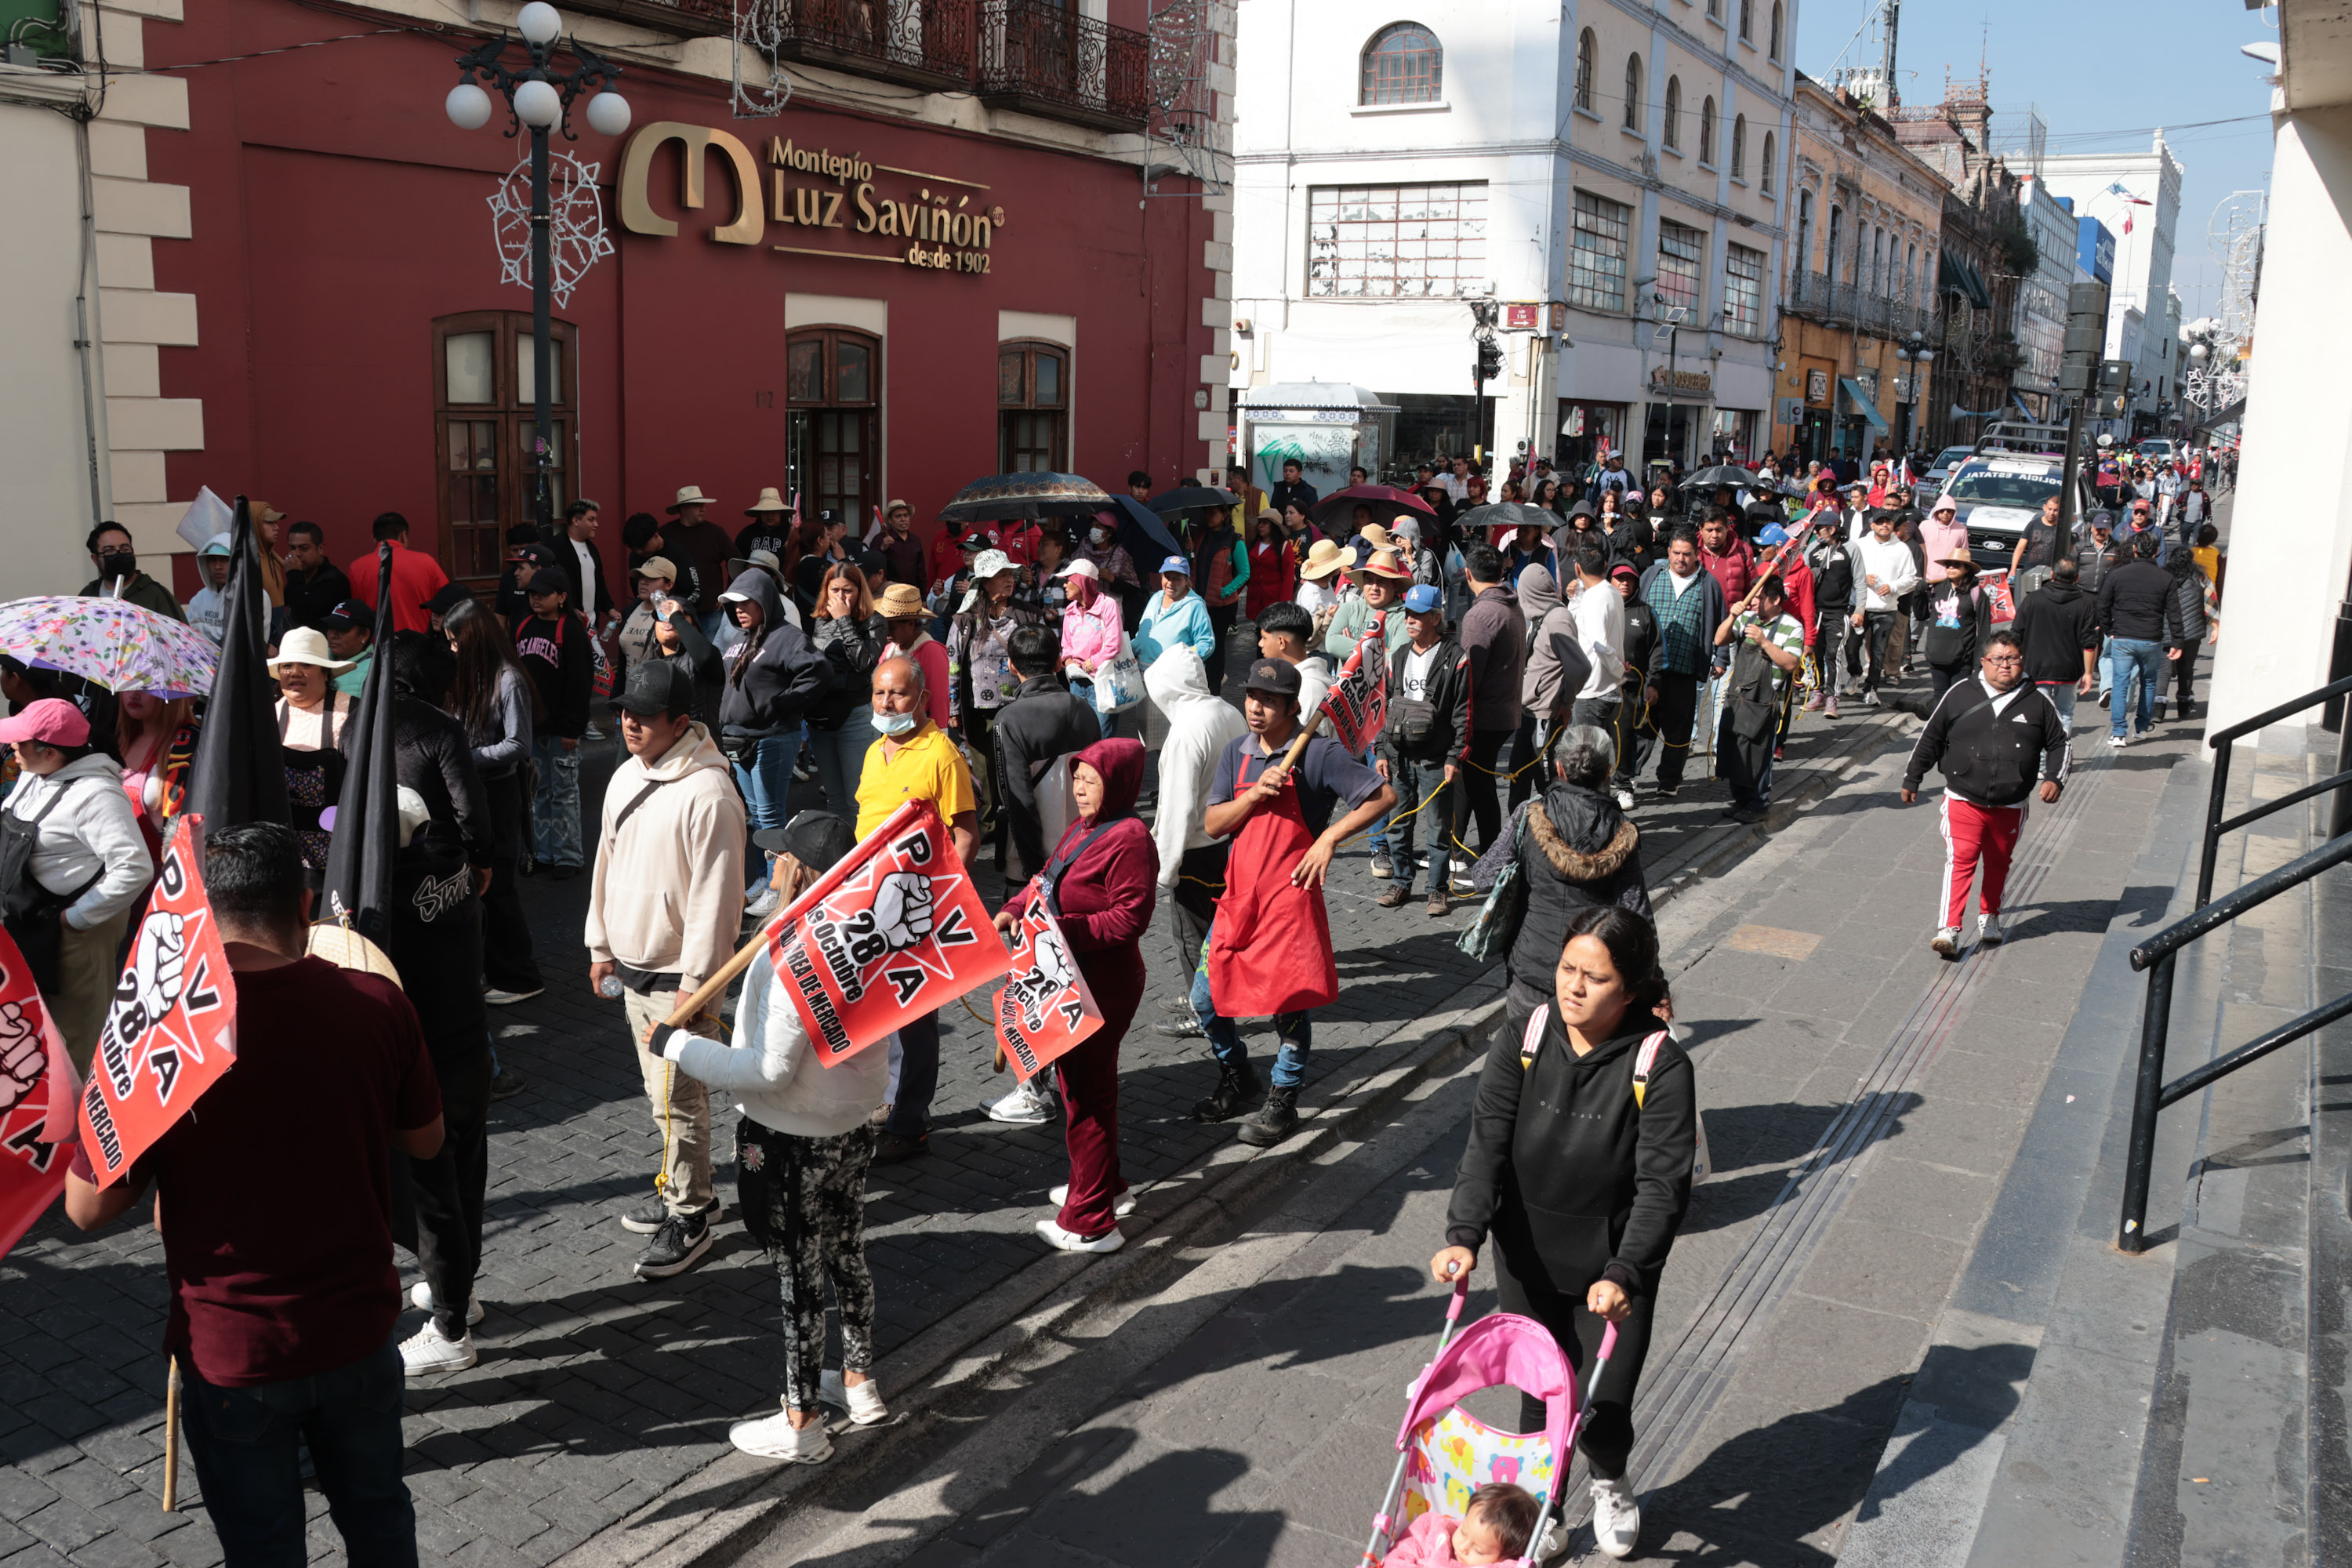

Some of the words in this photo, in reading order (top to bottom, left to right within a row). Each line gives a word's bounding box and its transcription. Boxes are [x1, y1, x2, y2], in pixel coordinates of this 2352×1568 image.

[771, 135, 873, 182] Montepío
[771, 168, 844, 229] Luz
[852, 183, 992, 249] Saviñón
[908, 241, 952, 269] desde
[954, 251, 991, 274] 1902
[751, 536, 782, 552] GAP
[525, 637, 559, 670] ANGELES
[1351, 669, 1370, 704] 28
[1370, 696, 1382, 724] A
[996, 750, 1005, 785] MICHAEL
[894, 829, 931, 865] P
[160, 851, 185, 899] P
[843, 913, 886, 966] 28
[936, 907, 977, 946] V
[813, 924, 863, 1001] Octubre
[187, 956, 220, 1014] V
[798, 974, 821, 996] DE
[885, 967, 927, 1007] A
[1022, 967, 1058, 1004] 28
[805, 990, 851, 1054] MERCADO
[1059, 1000, 1083, 1033] A
[1004, 1026, 1039, 1073] MERCADO
[149, 1047, 181, 1105] A
[85, 1090, 124, 1171] MERCADO
